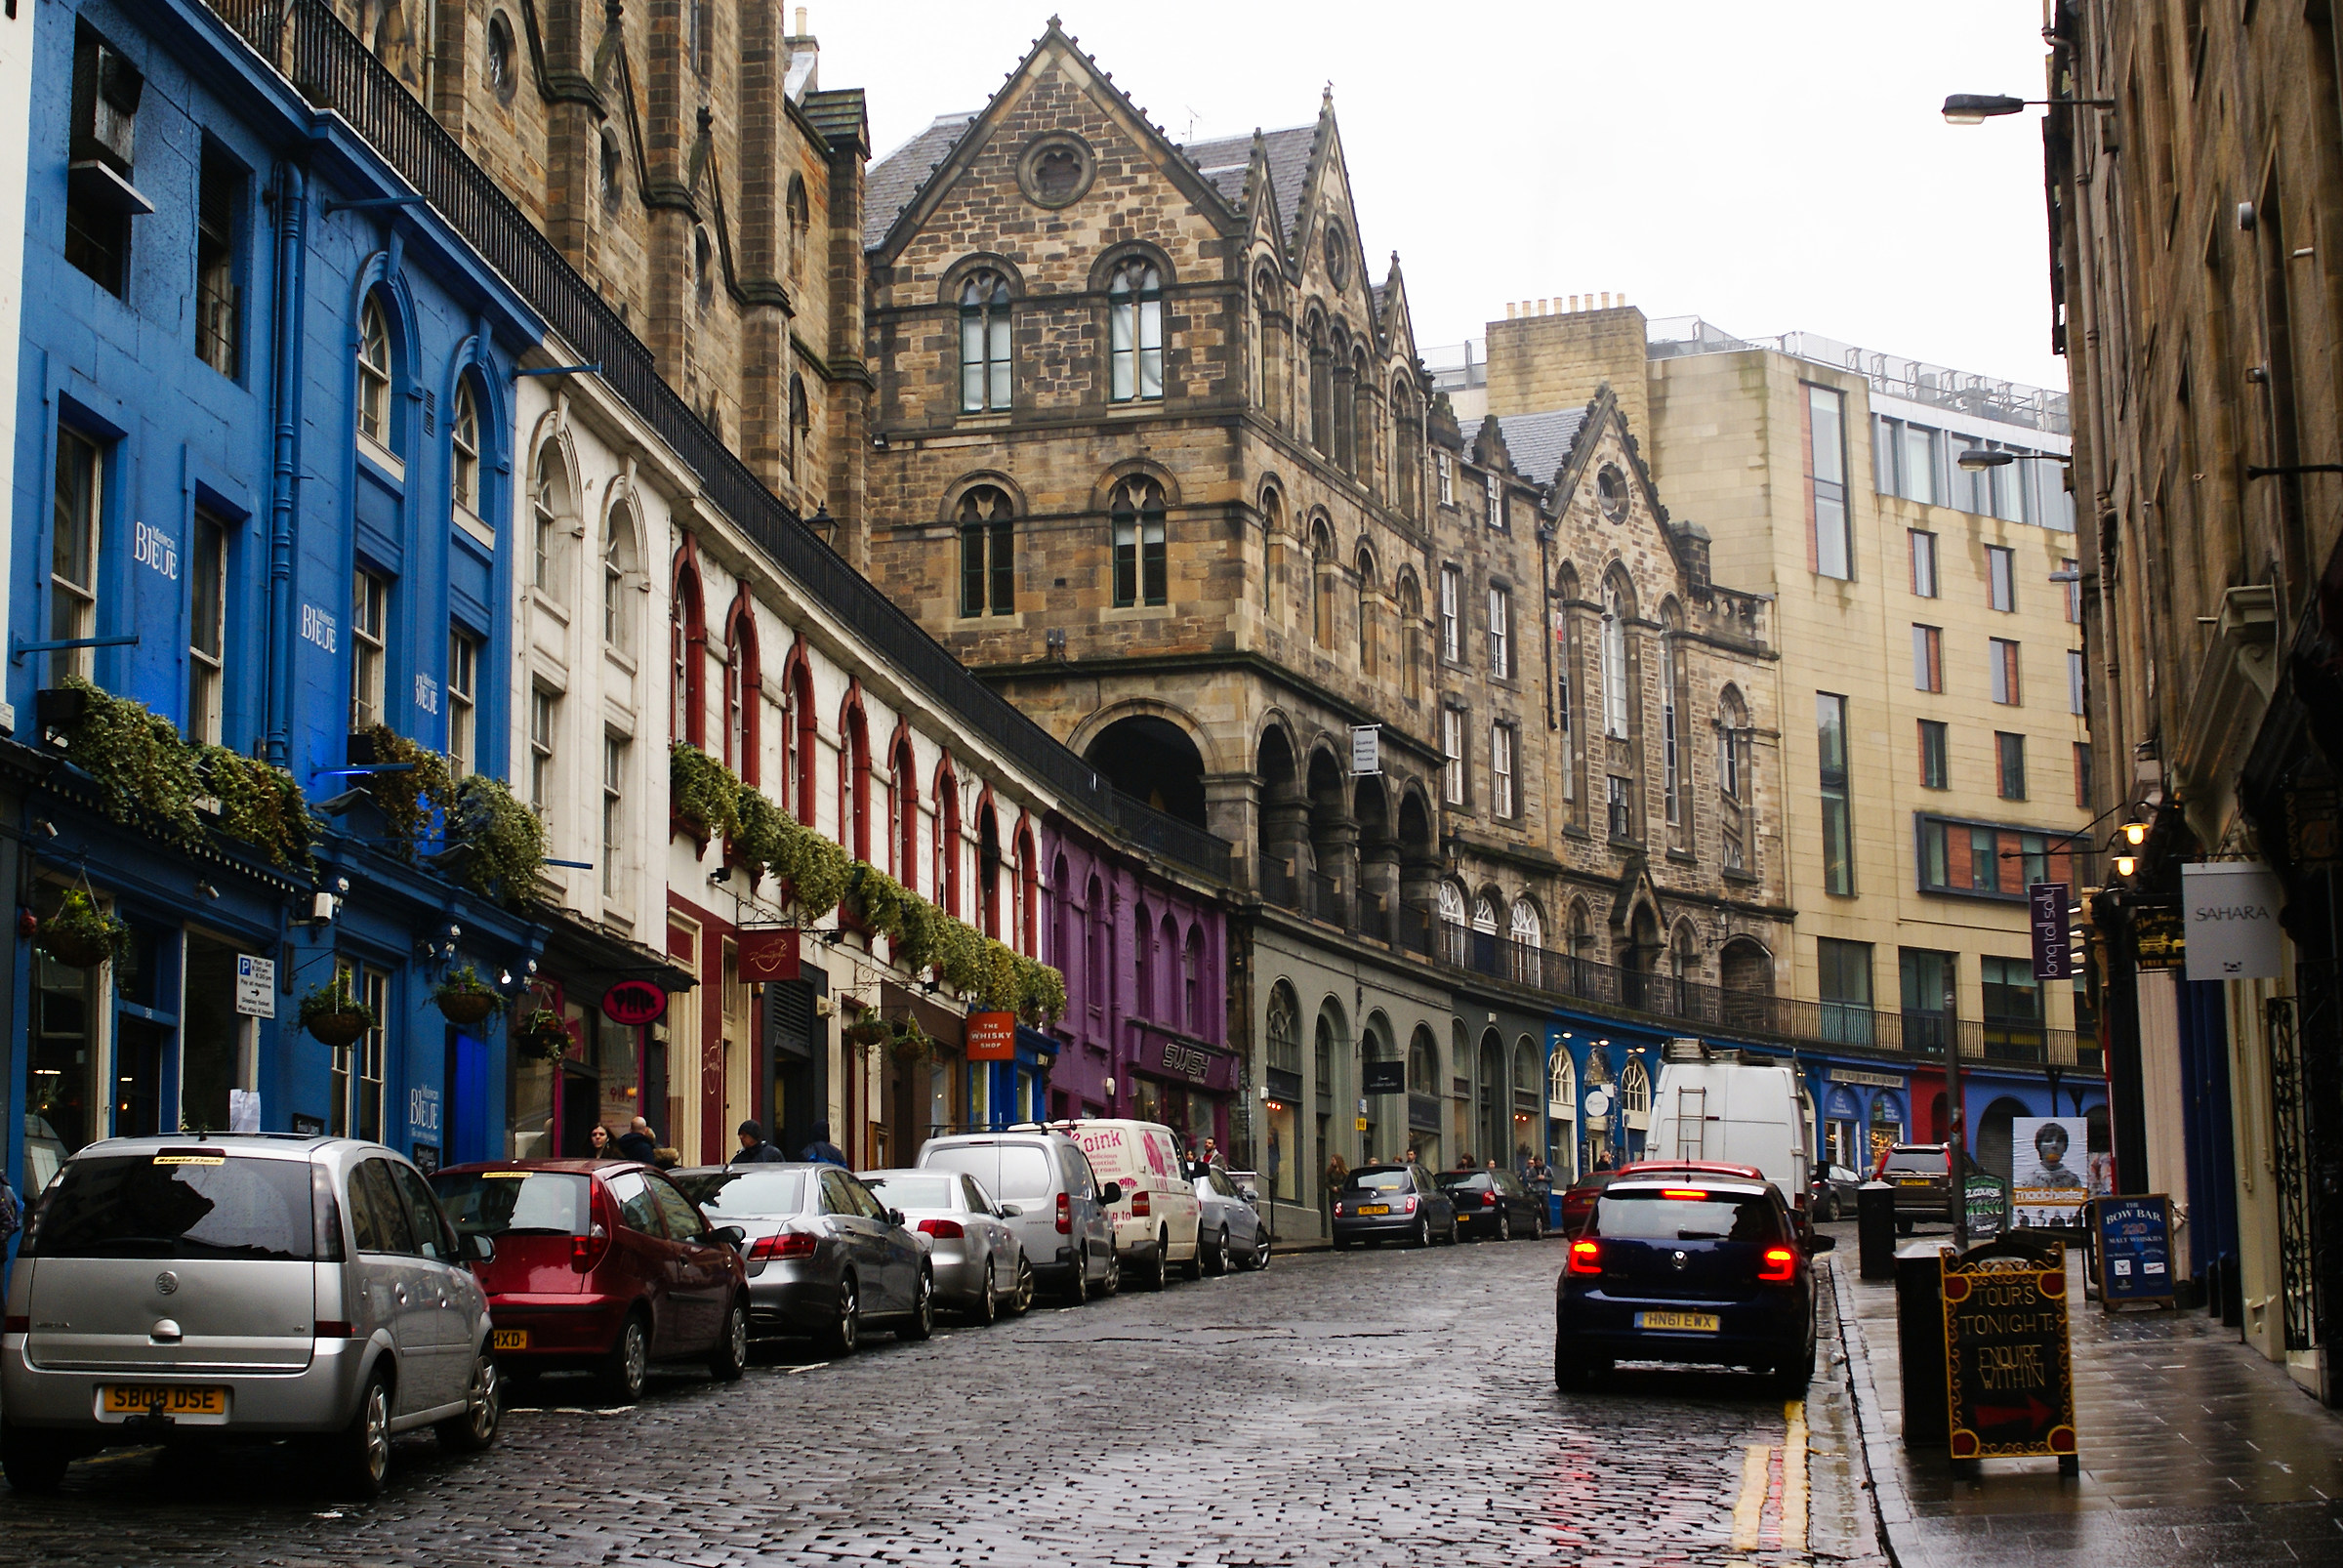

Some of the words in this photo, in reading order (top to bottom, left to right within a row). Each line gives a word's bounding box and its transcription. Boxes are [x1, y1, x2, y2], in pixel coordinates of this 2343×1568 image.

[2196, 906, 2270, 922] SAHARA
[242, 960, 250, 973] P
[1163, 1043, 1211, 1078] SWISH
[1084, 1130, 1122, 1153] oink
[2106, 1210, 2133, 1224] BOW
[2136, 1209, 2161, 1222] BAR
[1971, 1286, 2036, 1306] TOURS
[1648, 1313, 1680, 1326] HN61
[1684, 1316, 1712, 1328] EWX
[1978, 1344, 2042, 1368] ENQUIRE
[1978, 1366, 2045, 1389] WITHIN
[114, 1388, 169, 1408] SB08
[174, 1389, 216, 1408] DSE
